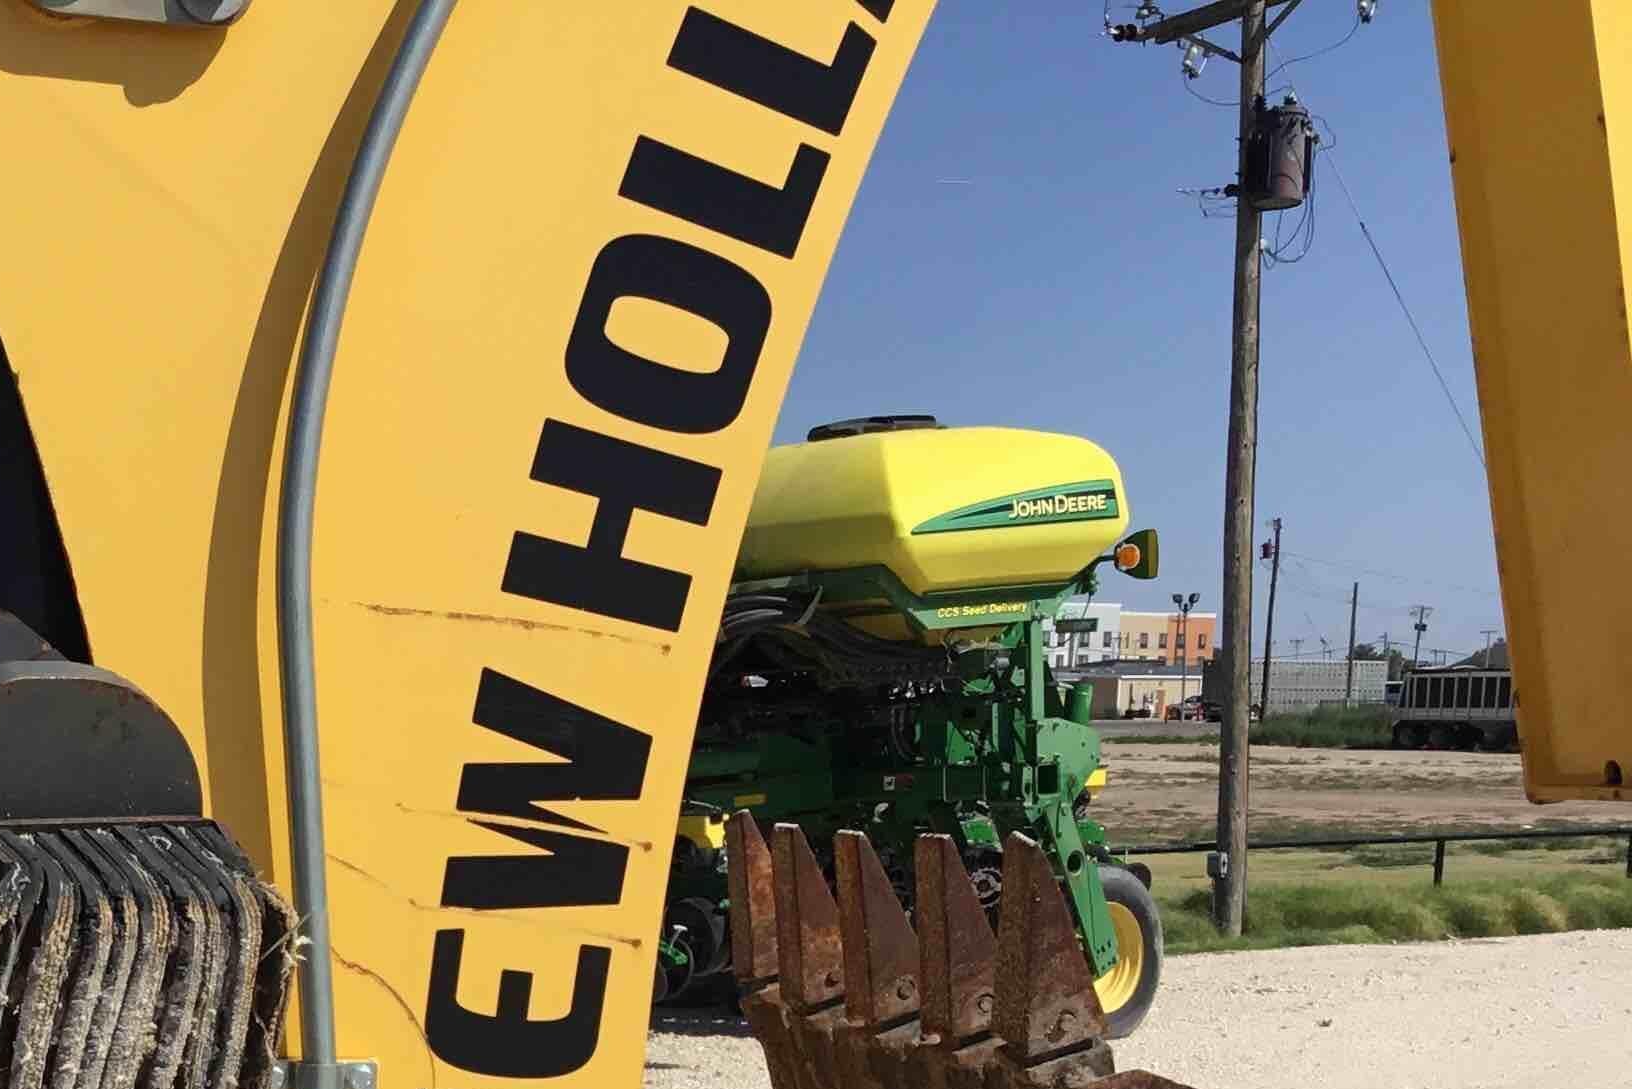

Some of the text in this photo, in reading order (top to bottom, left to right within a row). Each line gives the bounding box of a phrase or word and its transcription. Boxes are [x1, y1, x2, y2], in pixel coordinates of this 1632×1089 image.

[500, 0, 896, 632] HOLL
[1008, 494, 1107, 518] JOHN DEERE
[937, 607, 960, 618] CCS
[962, 604, 988, 616] Seed
